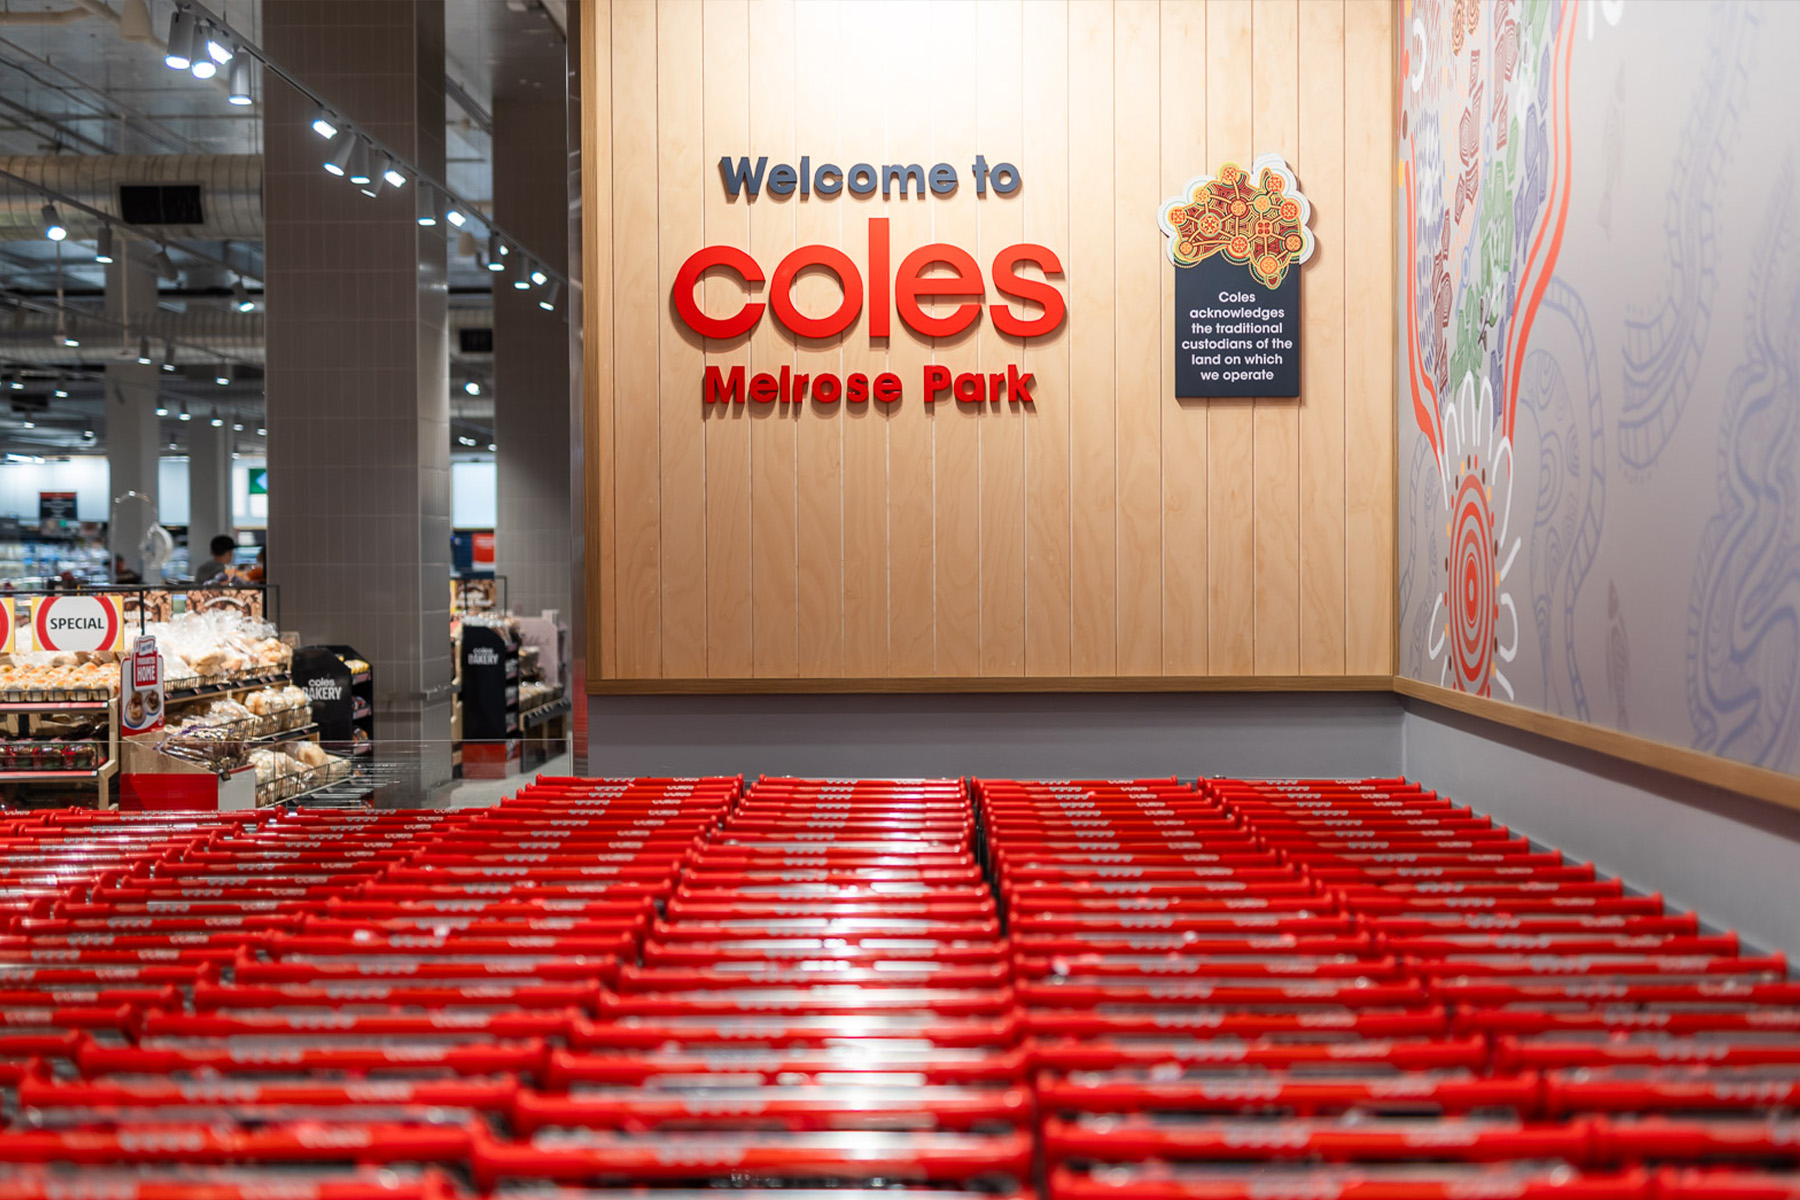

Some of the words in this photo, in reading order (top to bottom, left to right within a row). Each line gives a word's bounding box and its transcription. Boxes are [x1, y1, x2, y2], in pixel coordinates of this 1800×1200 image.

[719, 155, 958, 199] Welcome
[972, 155, 1020, 197] to
[672, 217, 1066, 340] coles
[1218, 291, 1256, 303] Coles
[1190, 307, 1285, 320] acknowledges
[1191, 322, 1213, 334] the
[1216, 322, 1283, 334] traditional
[1181, 338, 1253, 350] custodians
[1256, 338, 1269, 349] of
[1271, 338, 1293, 349] the
[1191, 354, 1221, 365] land
[1224, 356, 1241, 365] on
[1244, 354, 1283, 365] which
[1200, 371, 1219, 381] we
[1222, 369, 1274, 382] operate
[704, 365, 903, 406] Melrose
[923, 364, 1035, 405] Park
[50, 617, 105, 630] SPECIAL
[137, 665, 156, 682] HOME
[308, 677, 335, 687] coles
